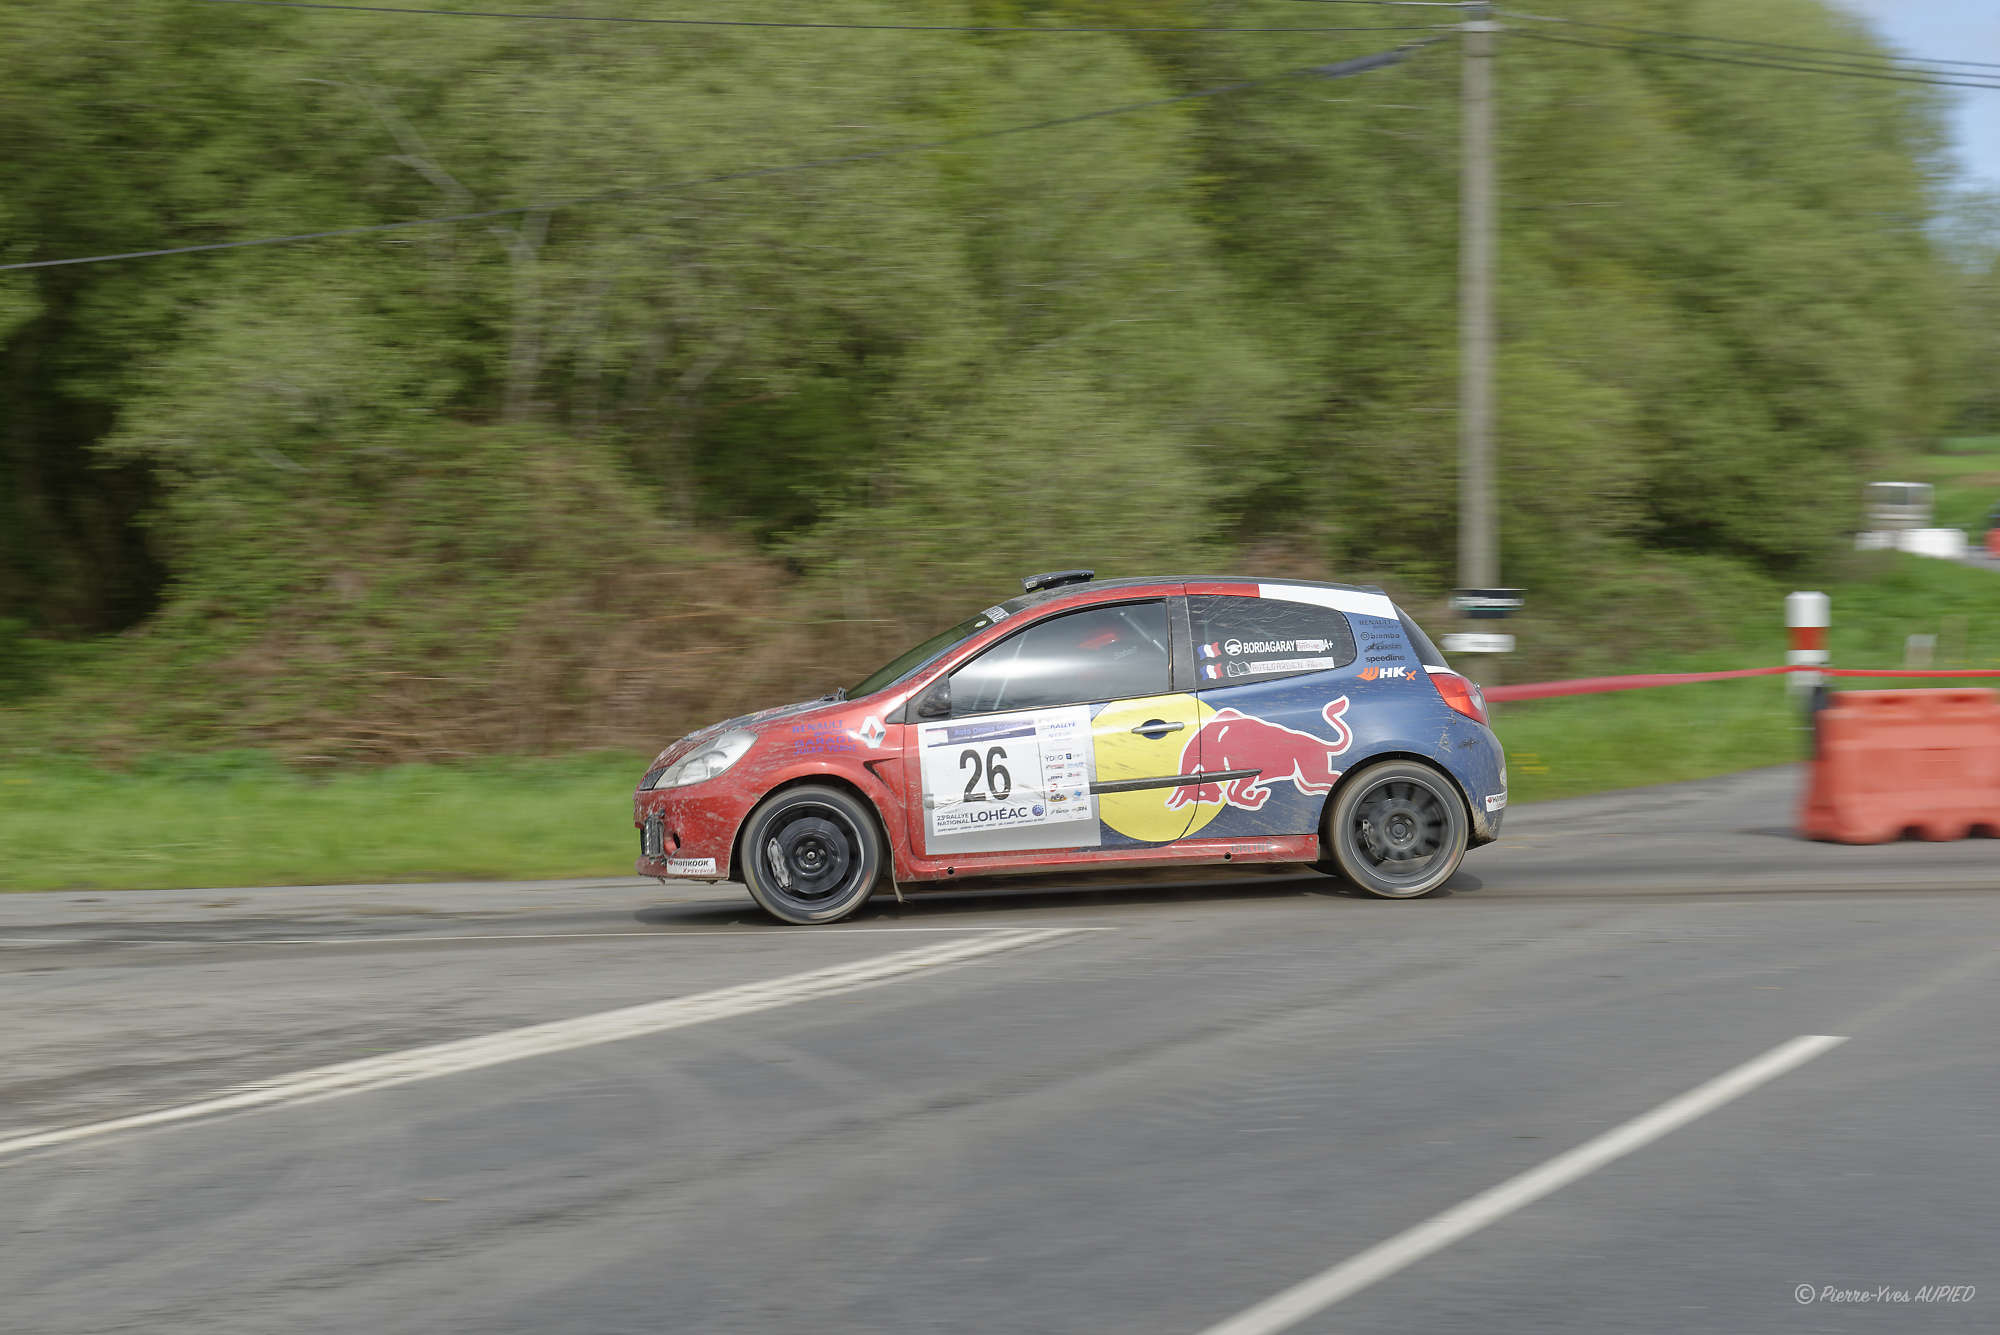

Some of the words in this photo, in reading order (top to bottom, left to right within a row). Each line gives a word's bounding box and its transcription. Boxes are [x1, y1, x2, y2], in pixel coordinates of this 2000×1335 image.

[1243, 640, 1296, 654] BORDAGARAY
[1366, 653, 1406, 664] speedline
[959, 745, 1012, 803] 26
[970, 807, 1028, 823] LOHÉAC
